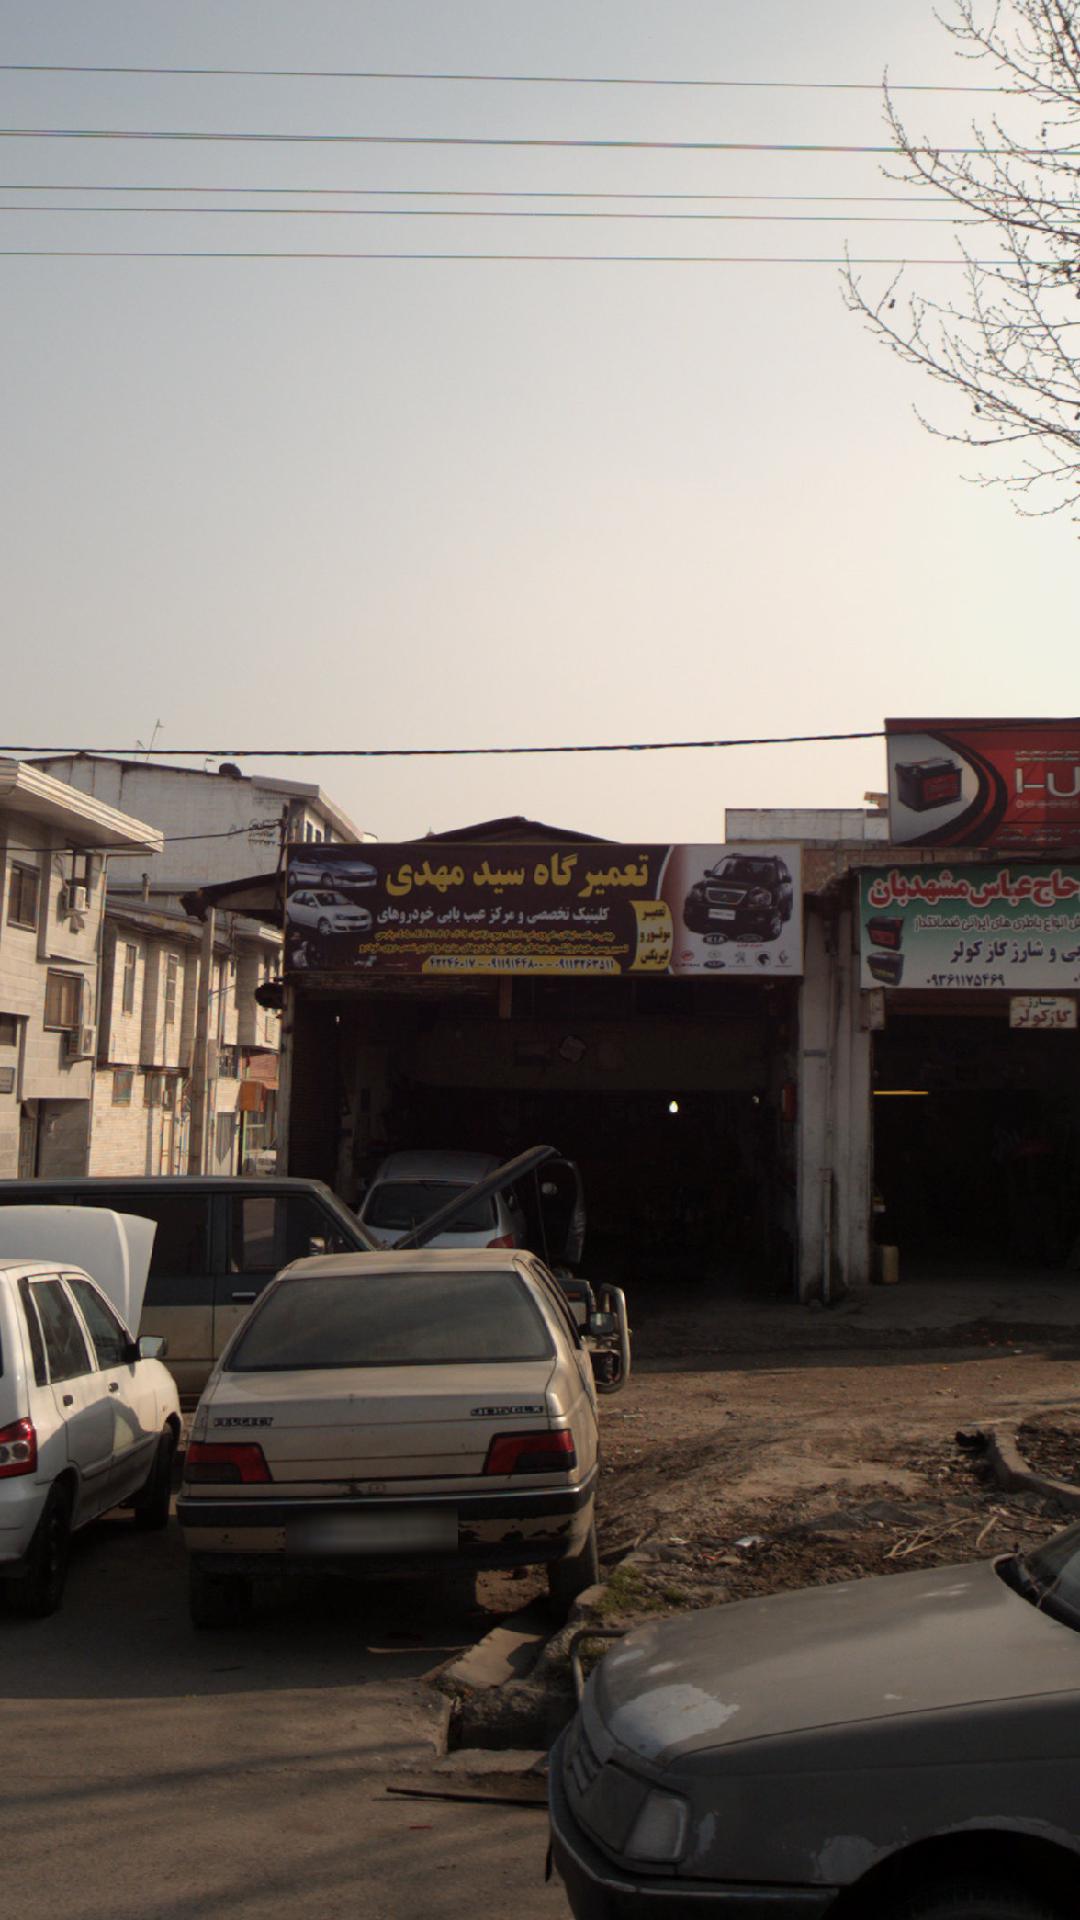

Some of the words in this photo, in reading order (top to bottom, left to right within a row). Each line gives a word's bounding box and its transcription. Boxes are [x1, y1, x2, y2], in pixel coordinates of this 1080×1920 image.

[385, 859, 466, 896] مهدی
[473, 860, 525, 895] سید
[868, 870, 969, 907] مشهدبان
[969, 868, 1032, 907] عباس
[1032, 869, 1080, 907] حاج
[377, 905, 433, 924] خودروهای
[437, 906, 461, 924] یابی
[462, 907, 487, 922] عیب
[488, 905, 515, 924] مرکز
[517, 912, 524, 924] و
[528, 907, 571, 924] تخصصی
[575, 906, 610, 922] کلینیک
[962, 914, 990, 931] ایرانی
[1013, 915, 1042, 931] باطری
[1043, 915, 1067, 932] انواع
[950, 941, 983, 963] کولر
[985, 941, 1007, 963] گاز
[1010, 941, 1043, 963] شارژ
[1049, 947, 1056, 963] و
